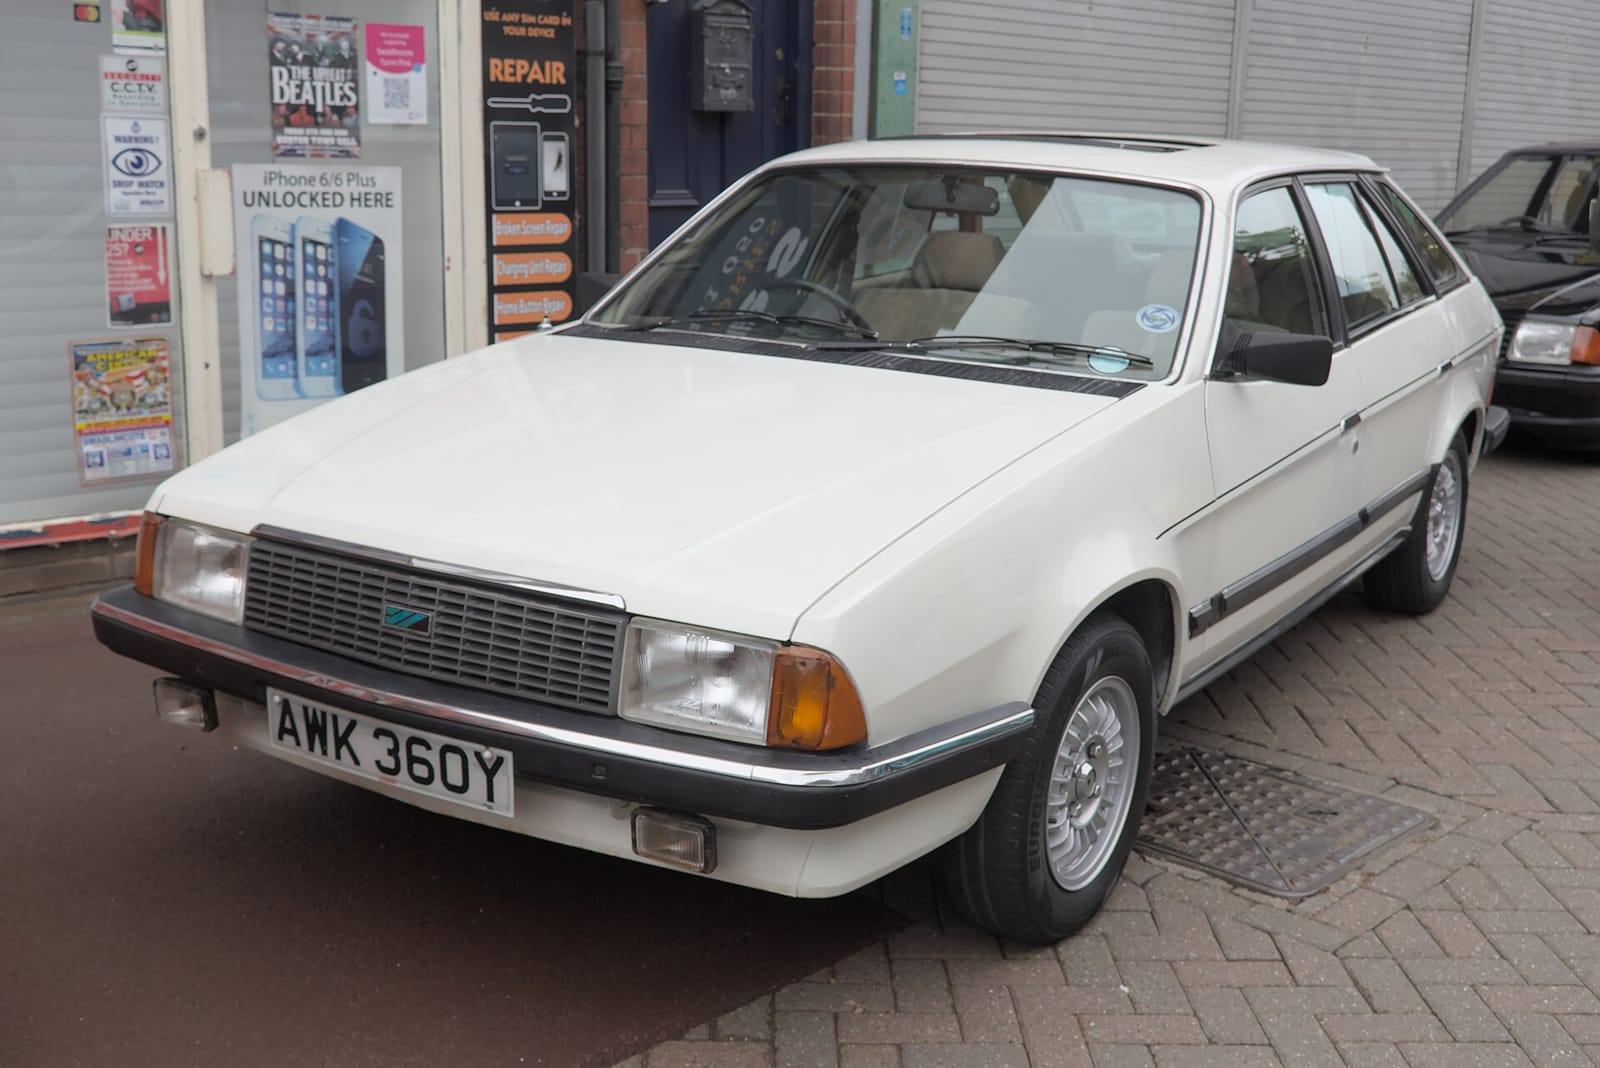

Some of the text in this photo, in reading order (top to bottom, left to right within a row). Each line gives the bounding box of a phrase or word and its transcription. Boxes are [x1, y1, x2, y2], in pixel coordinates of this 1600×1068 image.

[484, 11, 500, 21] USE
[501, 12, 520, 22] ANY
[521, 13, 537, 24] SIM
[538, 14, 560, 25] CARD
[503, 26, 555, 38] YOUR DEVICE
[104, 72, 161, 81] SECURITY
[292, 66, 312, 81] THE
[489, 57, 567, 84] REPAIR
[272, 66, 358, 113] BEATLES
[112, 180, 165, 189] SHOP WATCH
[263, 170, 376, 187] iPhone 6/6 Plus
[243, 191, 394, 208] UNLOCKED HERE
[106, 227, 152, 242] UNDER
[521, 220, 544, 235] Screen
[545, 219, 568, 238] Repair
[545, 259, 567, 276] Repair
[86, 349, 157, 363] AMERICAN
[277, 698, 504, 803] AWK 360Y
